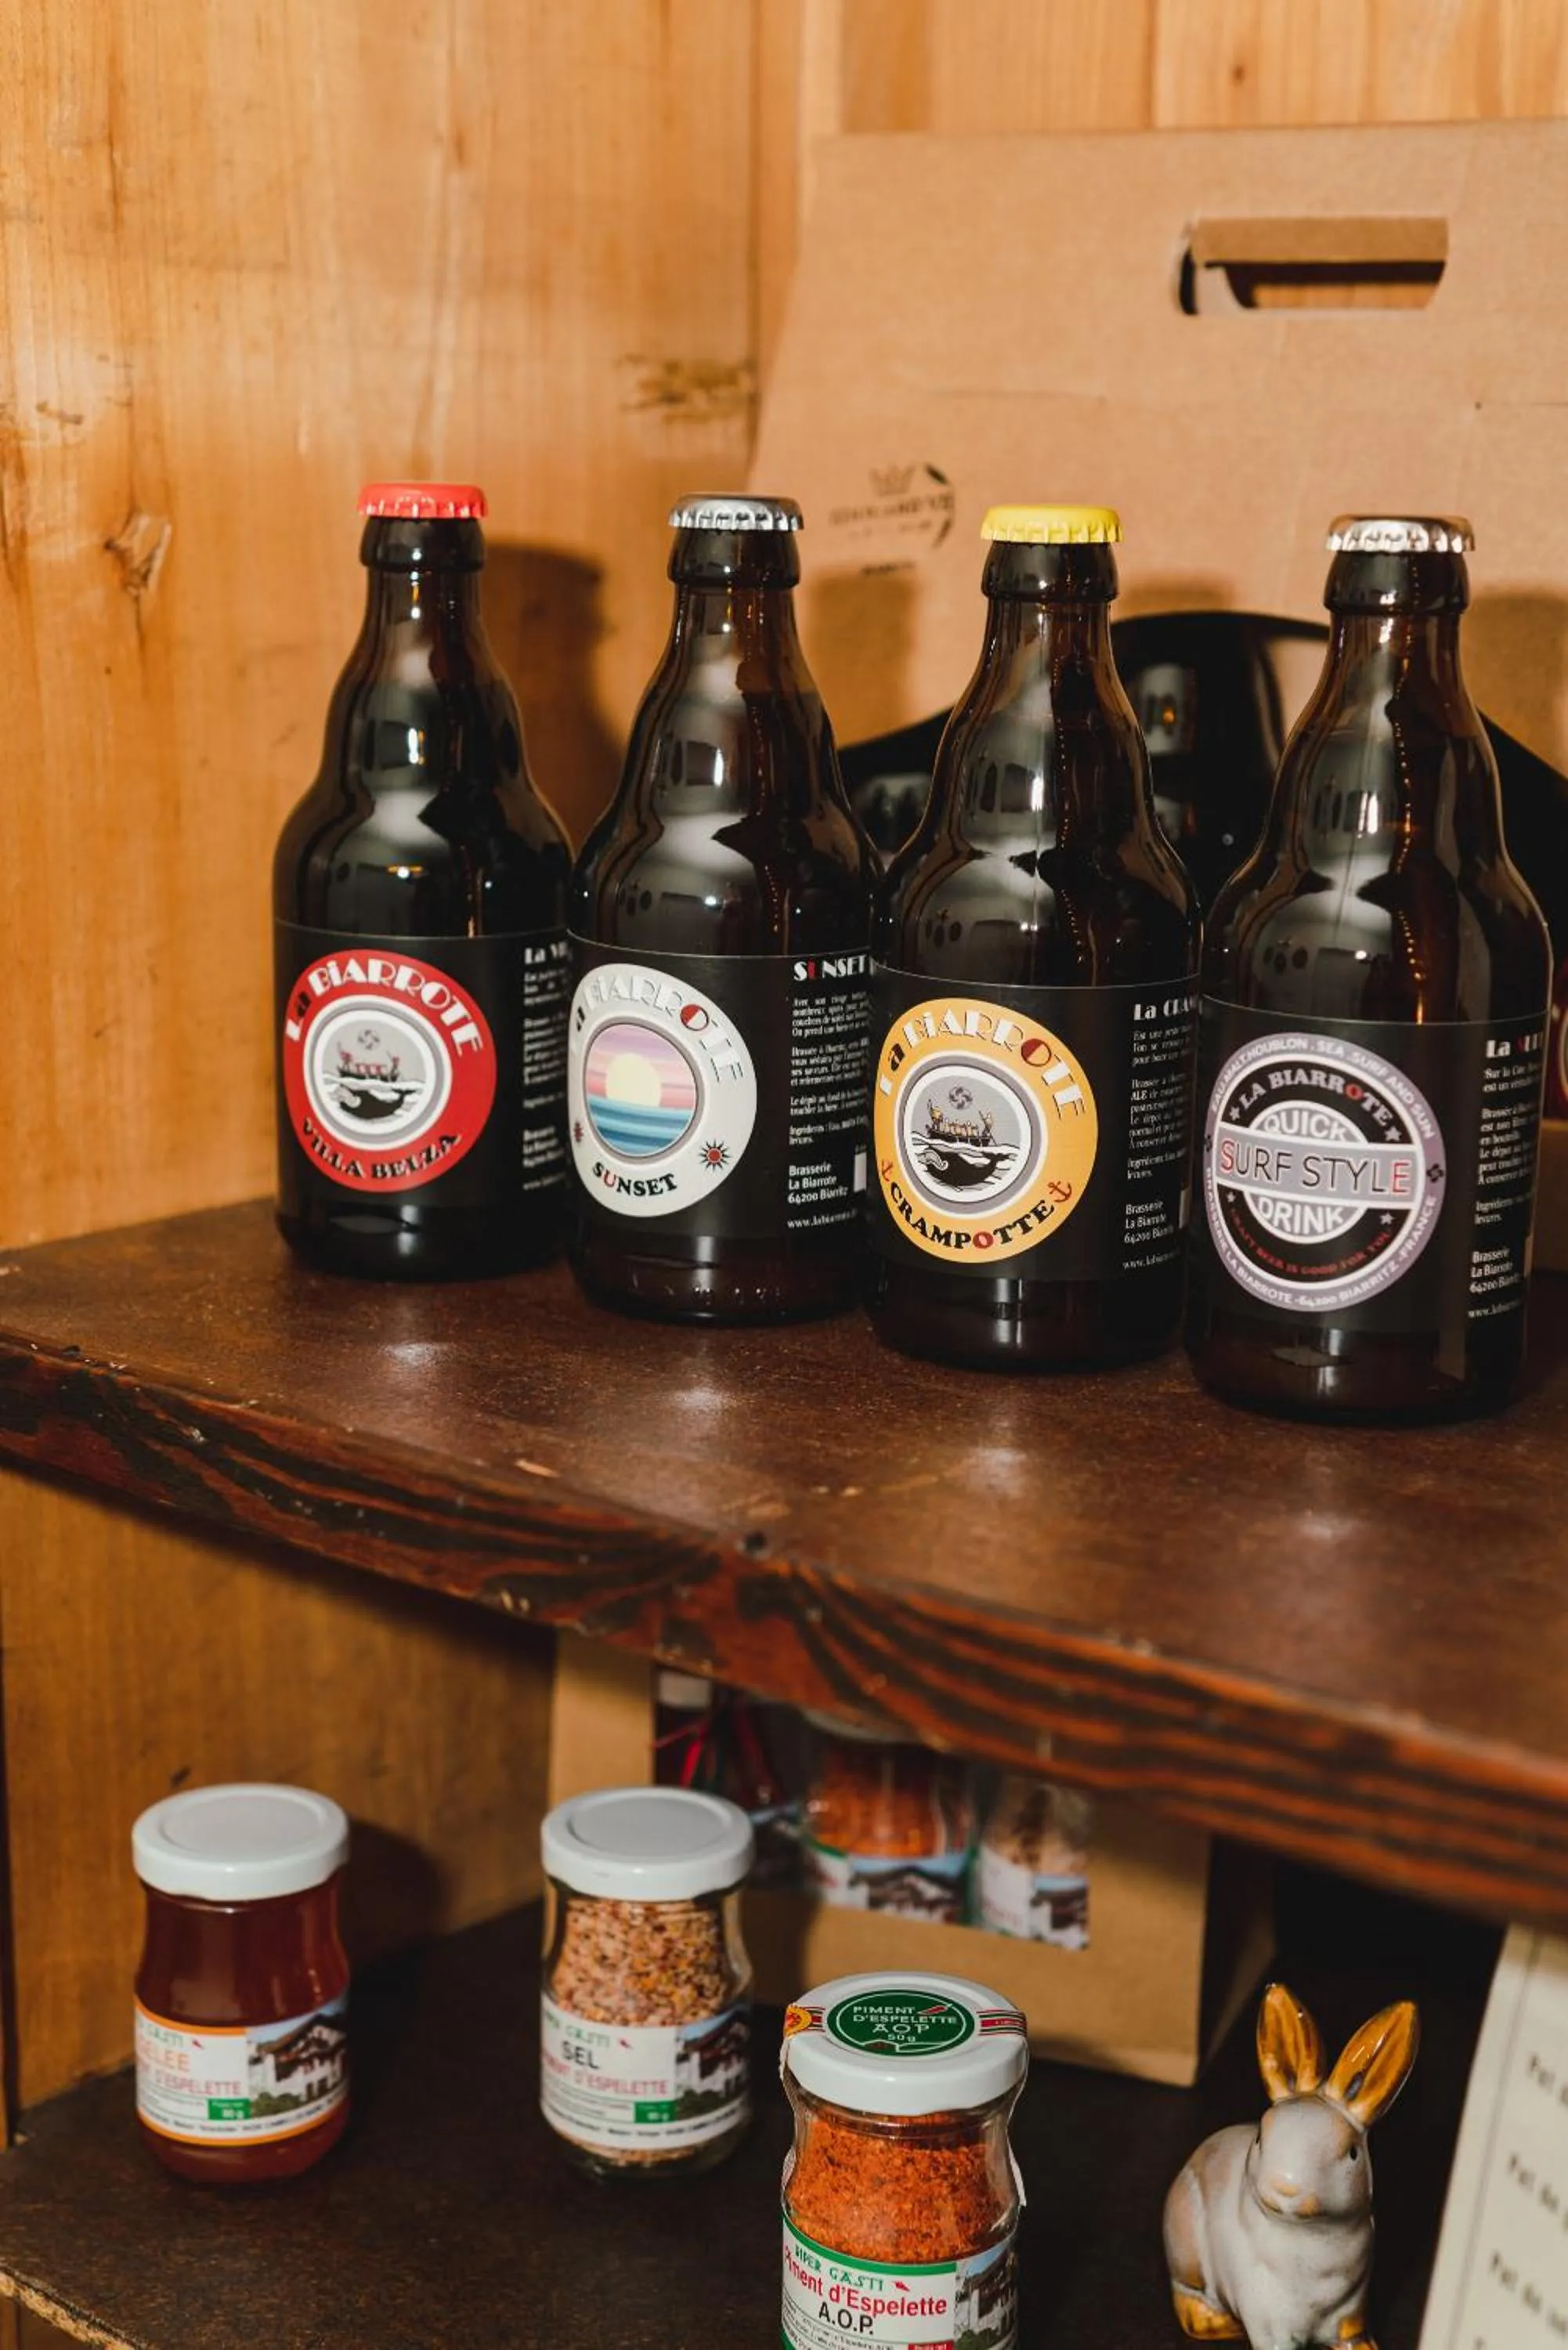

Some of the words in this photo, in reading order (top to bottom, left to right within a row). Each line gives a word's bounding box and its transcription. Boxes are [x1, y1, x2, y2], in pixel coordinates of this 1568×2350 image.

[1133, 1003, 1157, 1021] La
[1486, 1039, 1511, 1058] La
[1239, 1082, 1267, 1111] LA
[1267, 1068, 1394, 1127] BIARROTE
[1385, 1076, 1415, 1104] AND
[1411, 1103, 1436, 1140] SUN
[1263, 1108, 1348, 1142] QUICK
[592, 1162, 677, 1196] SUNSET
[789, 1161, 832, 1177] Brasserie
[789, 1178, 800, 1190] La
[802, 1176, 836, 1188] Biarrote
[1221, 1139, 1294, 1183] SURF
[1302, 1155, 1411, 1195] STYLE
[788, 1191, 818, 1205] 64200
[891, 1181, 1054, 1249] CRAMPOTTE
[1257, 1195, 1345, 1235] DRINK
[1125, 1217, 1135, 1229] La
[1338, 1260, 1400, 1302] BIARRITZ
[1471, 1266, 1483, 1278] La
[853, 2014, 958, 2024] D'ESPELETTE
[562, 2040, 601, 2070] SEL
[829, 2283, 948, 2317] d'Espelette
[818, 2301, 874, 2336] A.O.P.
